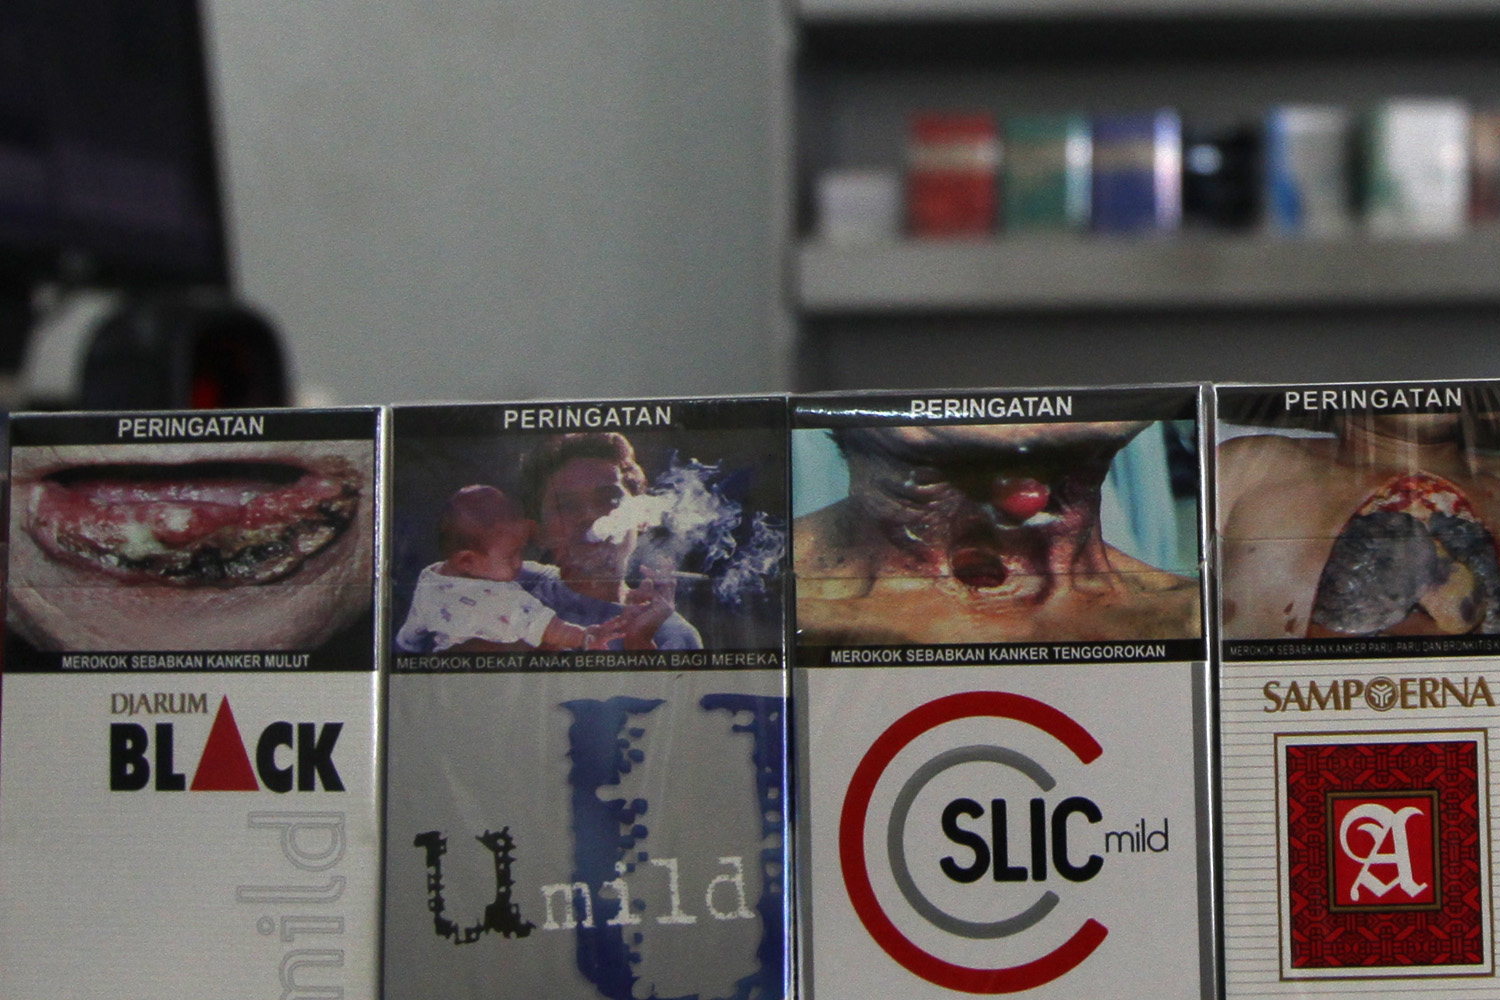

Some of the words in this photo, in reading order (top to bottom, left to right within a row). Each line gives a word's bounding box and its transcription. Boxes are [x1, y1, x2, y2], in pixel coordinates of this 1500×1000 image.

[910, 396, 1072, 419] PERINGATAN
[1285, 388, 1462, 410] PERINGATAN
[118, 416, 265, 438] PERINGATAN
[503, 405, 672, 430] PERINGATAN
[831, 650, 901, 663] MEROKOK
[906, 648, 985, 662] SEBABKAN
[989, 647, 1049, 660] KANKER
[1053, 645, 1166, 659] TENGGOROKAN
[1230, 646, 1274, 656] MEROKOK
[1277, 644, 1327, 655] SEBABKAN
[1329, 643, 1367, 653] KANKER
[1368, 641, 1421, 652] PARU-PARU
[1423, 641, 1441, 651] DAN
[1443, 640, 1492, 650] BRONKITIS
[62, 656, 128, 670] MEROKOK
[131, 656, 203, 669] SEBABKAN
[207, 655, 261, 668] KANKER
[265, 654, 310, 668] MULUT
[397, 657, 471, 669] MEROKOK
[476, 656, 524, 669] DEKAT
[529, 656, 570, 668] ANAK
[575, 655, 667, 667] BERBAHAYA
[671, 654, 706, 666] BAGI
[712, 653, 778, 666] MEREKA
[110, 692, 208, 716] DJARUM
[1263, 676, 1496, 713] SAMPOERNA
[940, 796, 1105, 884] SLIC
[1105, 818, 1169, 854] mild
[1340, 803, 1428, 901] A
[541, 856, 755, 930] mild
